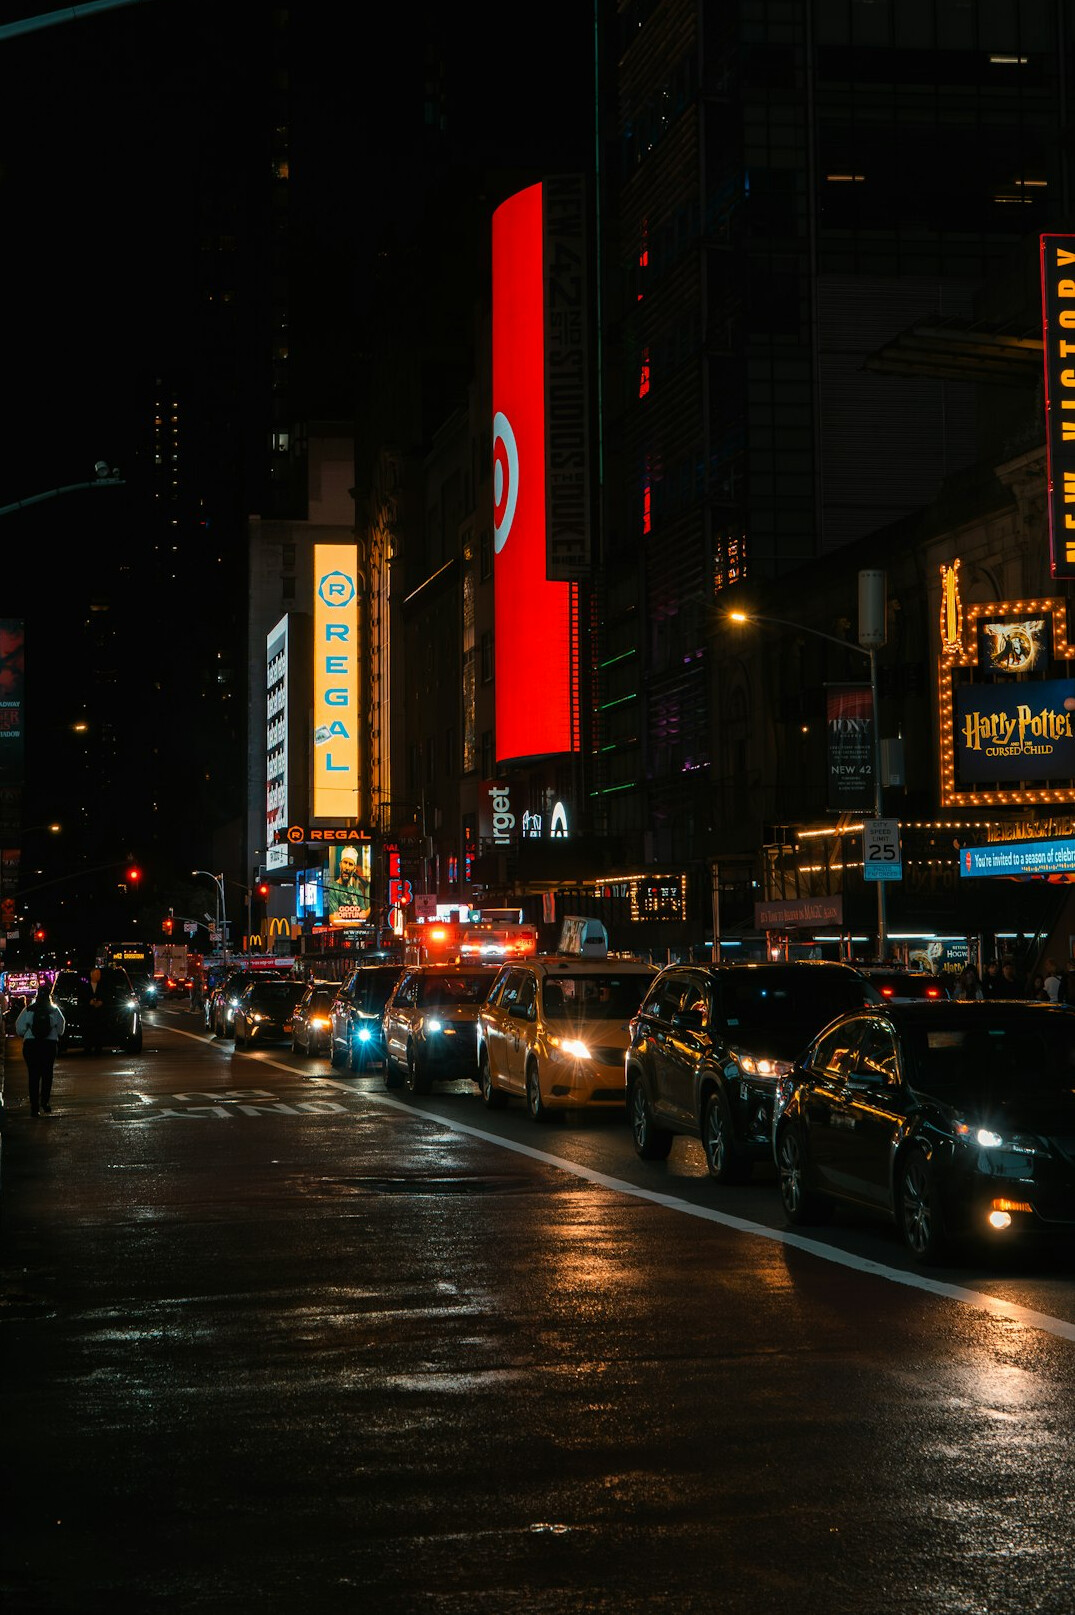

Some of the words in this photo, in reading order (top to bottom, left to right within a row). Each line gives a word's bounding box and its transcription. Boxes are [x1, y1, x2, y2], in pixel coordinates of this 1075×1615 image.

[548, 177, 583, 238] NEW
[550, 242, 582, 307] 42
[550, 350, 585, 469] STUDIOS
[551, 484, 585, 554] DUKE
[325, 623, 350, 772] REGAL
[828, 718, 871, 734] TONY
[961, 711, 1016, 751] Harry
[1016, 704, 1073, 751] Potter
[985, 746, 1021, 757] CURSED
[1023, 745, 1053, 755] CHILD
[831, 765, 856, 774] NEW
[859, 765, 872, 774] 42
[311, 830, 371, 839] REGAL
[868, 844, 896, 860] 25
[974, 853, 991, 868] You're
[992, 851, 1012, 867] invited
[1013, 853, 1020, 866] to
[1025, 852, 1046, 864] season
[1047, 848, 1054, 863] of
[1055, 847, 1075, 862] celebr
[334, 911, 367, 919] FORTUNE
[804, 904, 822, 920] MAGIC
